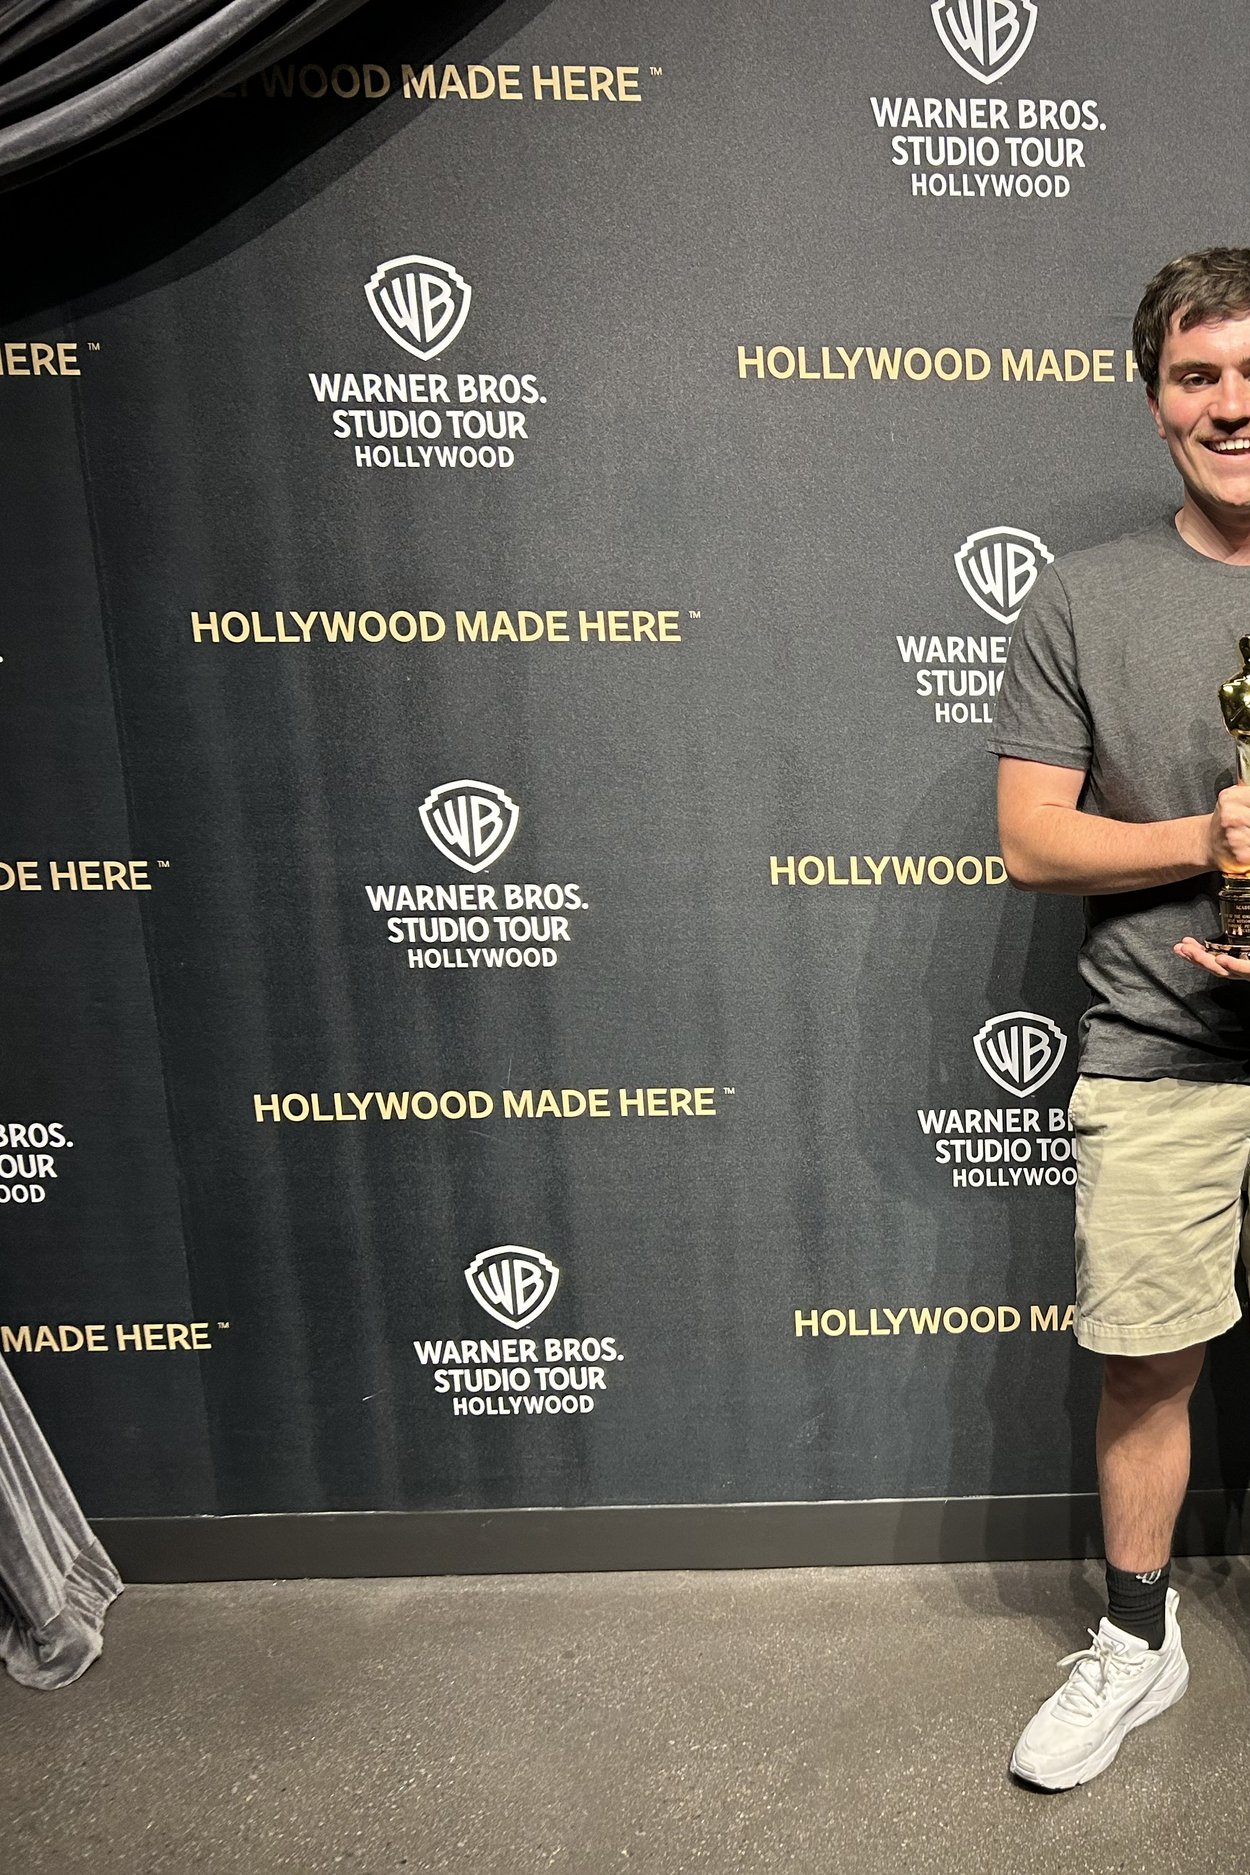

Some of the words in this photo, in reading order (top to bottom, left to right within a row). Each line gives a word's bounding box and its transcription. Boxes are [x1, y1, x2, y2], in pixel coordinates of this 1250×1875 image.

[403, 64, 524, 100] MADE
[532, 65, 642, 102] HERE
[869, 96, 1011, 129] WARNER
[1018, 99, 1107, 131] BROS.
[891, 135, 1000, 167] STUDIO
[1004, 136, 1086, 168] TOUR
[911, 172, 1071, 198] HOLLYWOOD
[0, 342, 81, 376] ERE
[737, 345, 991, 381] HOLLYWOOD
[1001, 348, 1116, 383] MADE
[308, 373, 451, 403] WARNER
[456, 373, 548, 404] BROS.
[332, 409, 442, 439] STUDIO
[446, 409, 529, 440] TOUR
[354, 445, 515, 468] HOLLYWOOD
[190, 610, 446, 643] HOLLYWOOD
[455, 610, 570, 642] MADE
[578, 610, 682, 642] HERE
[895, 635, 1012, 664] WARNE
[935, 702, 997, 724] HOLL
[49, 860, 152, 891] HERE
[769, 855, 1009, 886] HOLLYWOOD
[364, 884, 499, 912] WARNER
[503, 883, 589, 911] BROS.
[387, 916, 490, 943] STUDIO
[493, 915, 572, 942] TOUR
[407, 947, 558, 969] HOLLYWOOD
[253, 1090, 494, 1123] HOLLYWOOD
[502, 1088, 611, 1119] MADE
[619, 1087, 717, 1117] HERE
[916, 1108, 1041, 1135] WARNER
[935, 1138, 1032, 1164] STUDIO
[794, 1306, 1021, 1337] HOLLYWOOD
[0, 1324, 109, 1353] MADE
[115, 1322, 212, 1351] HERE
[413, 1338, 539, 1365] WARNER
[544, 1336, 625, 1363] BROS.
[434, 1367, 531, 1393] STUDIO
[535, 1366, 607, 1391] TOUR
[452, 1394, 595, 1416] HOLLYWOOD
